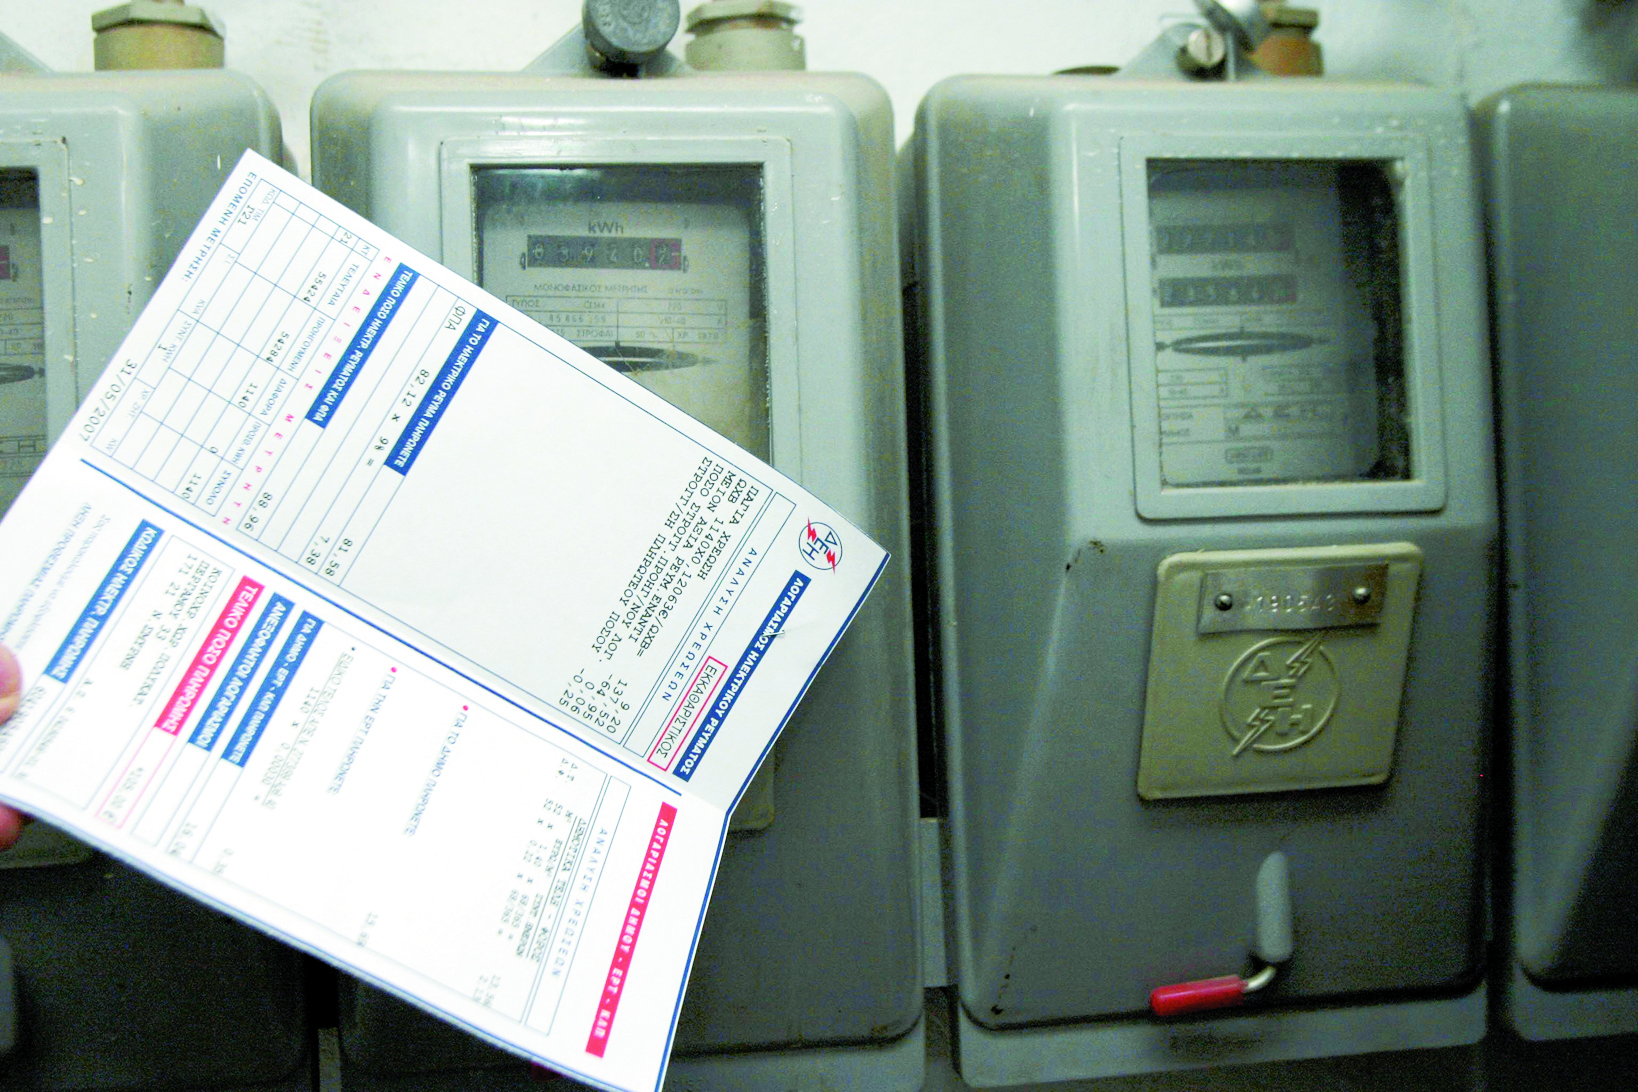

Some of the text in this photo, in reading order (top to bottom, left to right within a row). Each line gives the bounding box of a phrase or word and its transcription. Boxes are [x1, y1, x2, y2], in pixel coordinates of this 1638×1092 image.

[237, 204, 254, 224] Γ21
[588, 222, 624, 234] kWh
[327, 263, 358, 305] ΤΕΛΕΥΤΑΙΑ
[79, 171, 256, 445] ΕΠΟΜΕΝΗ ΜΕΤΡΗΣΗ: 31/05/2007
[287, 316, 325, 371] ΠΡΟΗΓΟΥΜΕΝΗ
[181, 231, 351, 498] 21 55424 54284 1140 0 1140
[221, 256, 391, 524] ΕΝΔΕΙΞΕΙΣ ΜΕΤΡΗΤΗ
[243, 267, 413, 530] ΤΕΛΙΚΟ ΠΟΣΟ ΗΛΕΚΤΡ. ΡΕΥΜΑΤΟΣ ΚΑΙ ΦΠΑ 88,96
[259, 378, 286, 416] ΔΙΑΦΟΡΑ
[305, 305, 465, 565] ΦΠΑ 82,12 9% 7,38
[325, 316, 490, 576] ΓΙΑ ΤΟ ΗΛΕΚΤΡΙΚΟ ΡΕΥΜΑ ΠΛΗΡΩΝΕΤΕ 81,58
[206, 470, 231, 505] ΣΥΝΟΛΟ
[699, 463, 724, 496] ΠΟΣΟ
[725, 477, 748, 505] ΩΧΒ
[177, 553, 197, 574] 171
[799, 526, 840, 563] ΔΕΗ
[164, 581, 179, 595] 21
[558, 456, 712, 706] ΣΤΡΟΓΓ/ΣΗ ΠΛΗΡΩΤΕΟΥ ΠΟΣΟΥ -0,25
[582, 470, 736, 720] ΜΕΙΟΝ ΑΞΙΑ ΡΕΥΜ.ΕΝΑΝΤΙ -64,95
[48, 524, 158, 680] ΚΩΔΙΚΟΣ ΗΛΕΚΤΡ. ΠΛΗΡΩΜΗΣ
[221, 581, 259, 632] ΤΕΛΙΚΟ
[605, 485, 758, 733] ΠΑΓΙΑ ΧΡΕΩΣΗ 9,20
[156, 623, 170, 642] 33
[299, 616, 317, 636] ΓΙΑ
[661, 547, 757, 701] ΑΝΑΛΥΣΗ ΧΡΕΩΣΕΩΝ
[200, 626, 233, 667] ΠΟΣΟ
[283, 631, 308, 665] ΔΗΜΟ
[598, 632, 622, 663] ΛΟΓ.
[192, 598, 287, 750] ΑΝΕΞΟΦΛΗΤΟΙ ΛΟΓΑΡΙΑΣΜΟΙ
[269, 665, 289, 688] ΕΡΤ
[328, 650, 353, 687] ΕΙΔΙΚΟ
[380, 674, 395, 689] ΓΙΑ
[677, 575, 806, 776] ΛΟΓΑΡΙΑΣΜΟΣ ΗΛΕΚΤΡΙΚΟΥ ΡΕΥΜΑΤΟΣ
[159, 662, 211, 735] ΠΛΗΡΩΜΗΣ
[255, 689, 276, 713] ΚΛΠ
[311, 683, 336, 719] ΤΕΛΟΣ
[369, 694, 385, 711] ΤΗΝ
[570, 681, 594, 714] 0,06
[593, 679, 627, 727] 137,52
[652, 664, 717, 758] ΕΚΚΑΘΑΡΙΣΤΙΚΟΣ
[226, 707, 266, 766] ΠΛΗΡΩΝΕΤΕ
[360, 715, 374, 735] ΕΡΤ
[447, 732, 458, 744] ΤΟ
[453, 713, 467, 727] ΓΙΑ
[431, 745, 452, 779] ΔΗΜΟ
[551, 828, 607, 975] ΑΝΑΛΥΣΗ ΧΡΕΩΣΕΩΝ
[592, 816, 669, 1040] ΛΟΓΑΡΙΑΣΜΟΙ ΔΗΜΟΥ ΕΡΤ ΚΛΠ
